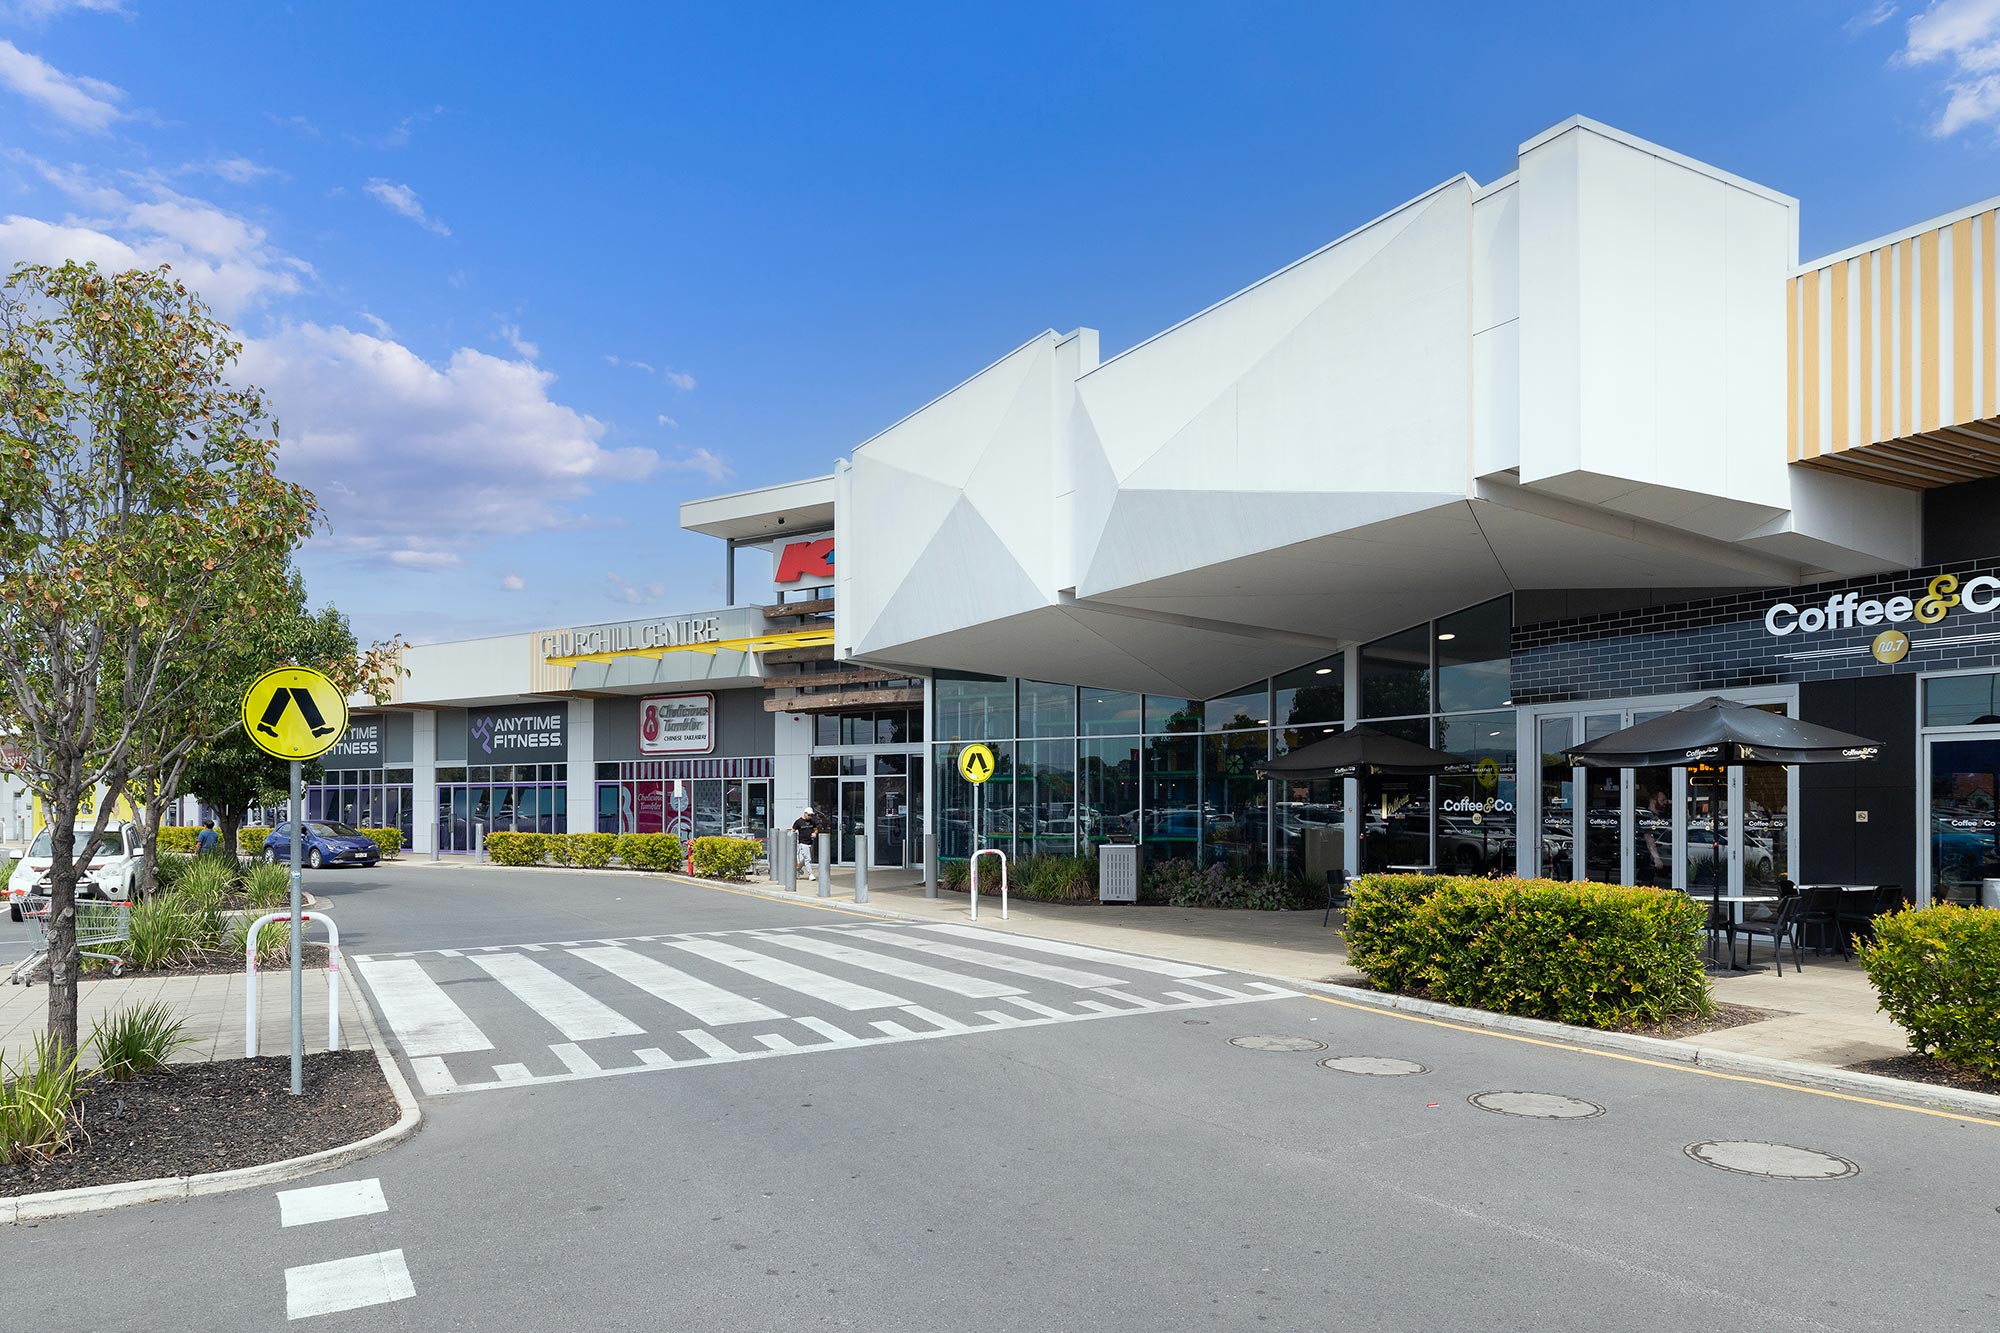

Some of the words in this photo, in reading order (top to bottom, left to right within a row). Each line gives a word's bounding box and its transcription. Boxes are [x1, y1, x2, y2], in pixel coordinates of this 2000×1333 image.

[540, 626, 638, 658] CHURCHILL
[641, 617, 720, 649] CENTRE
[494, 715, 561, 732] ANYTIME
[664, 718, 704, 732] Tumbler
[344, 726, 377, 740] TIME
[494, 732, 561, 749] FITNESS
[1444, 796, 1513, 813] Coffee&Co
